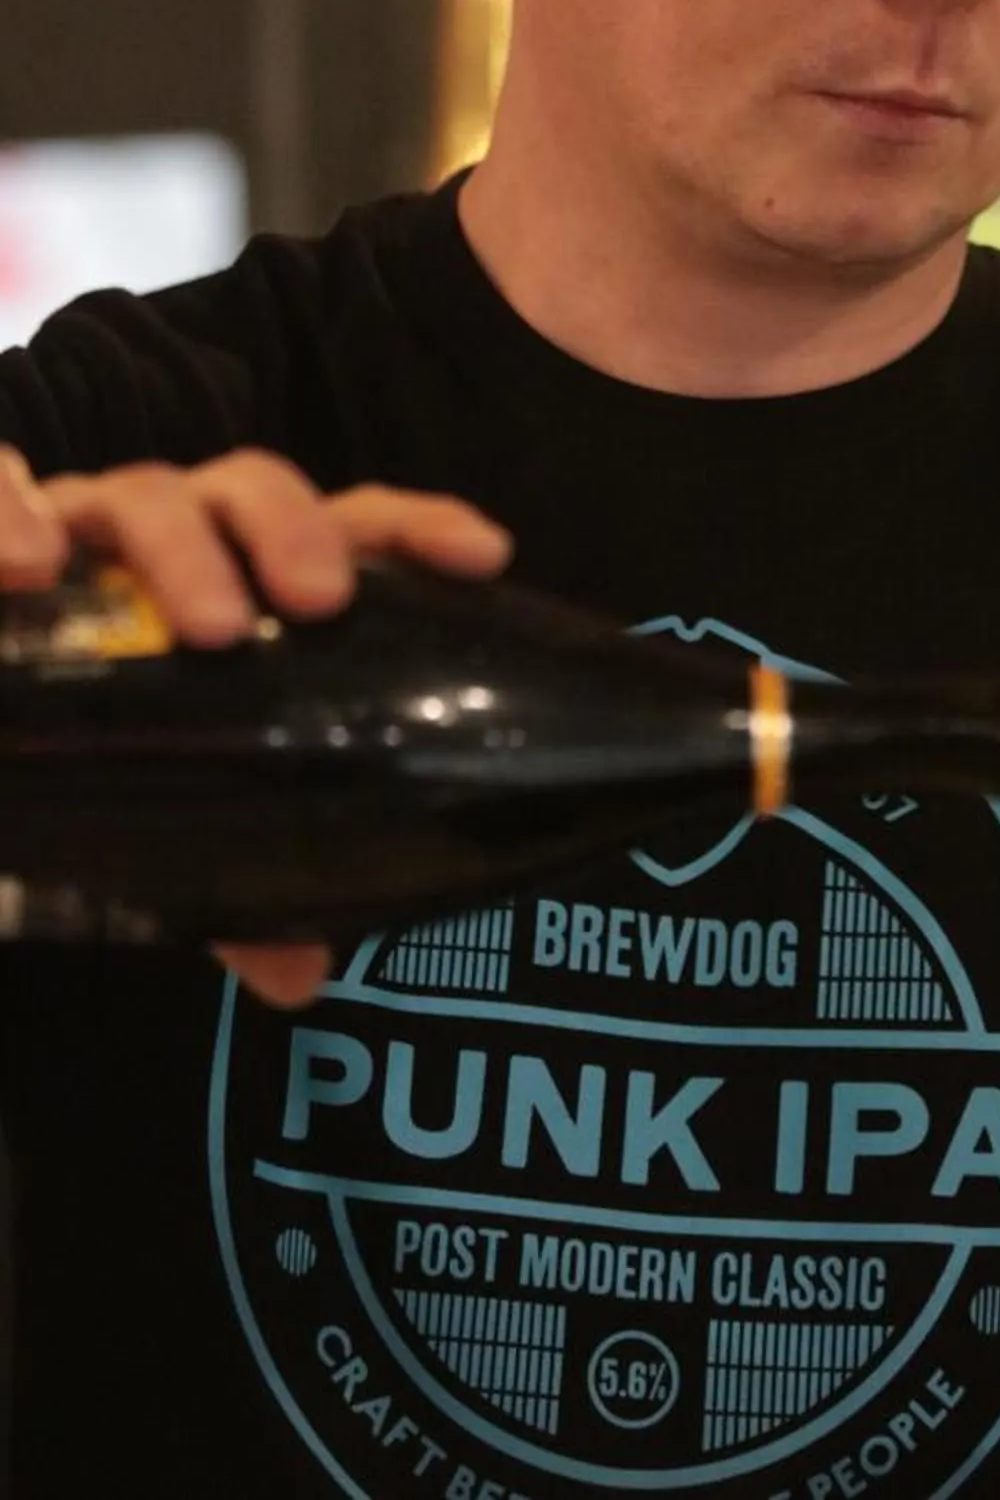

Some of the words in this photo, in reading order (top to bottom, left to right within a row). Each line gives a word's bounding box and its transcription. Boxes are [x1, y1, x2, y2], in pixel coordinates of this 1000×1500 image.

[533, 899, 798, 987] BREWDOG
[281, 1026, 725, 1193] PUNK
[394, 1220, 509, 1282] POST
[519, 1233, 697, 1303] MODERN
[711, 1251, 887, 1311] CLASSIC
[316, 1325, 447, 1477] CRAFT
[448, 1466, 531, 1500] BE
[806, 1368, 966, 1500] PEOPLE
[599, 1358, 668, 1400] 5.6%
